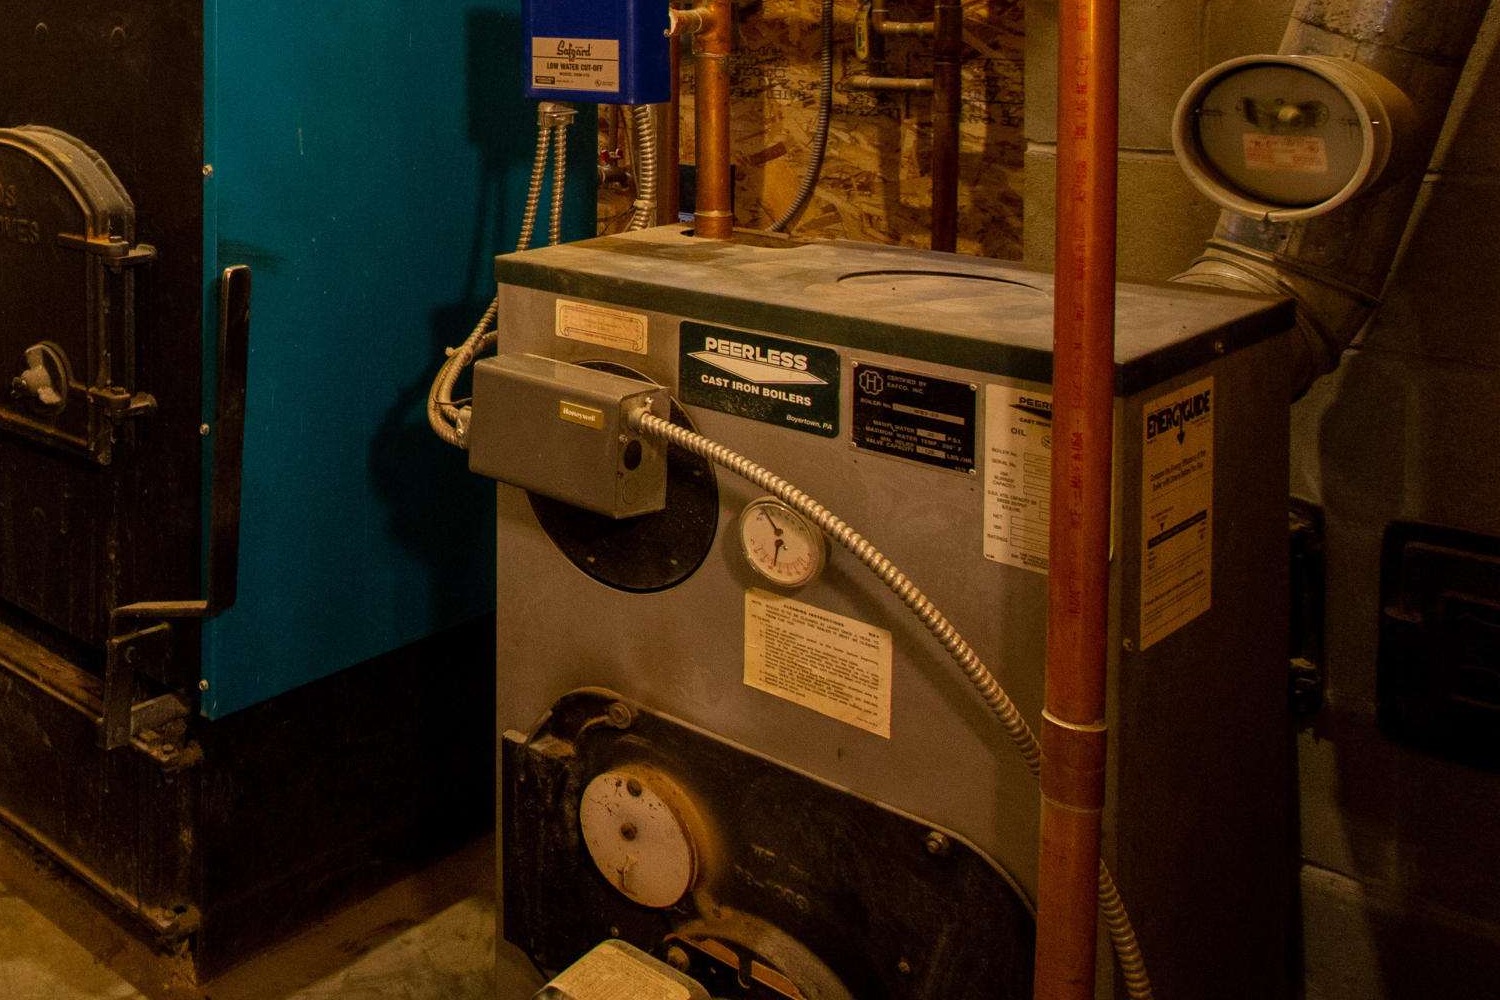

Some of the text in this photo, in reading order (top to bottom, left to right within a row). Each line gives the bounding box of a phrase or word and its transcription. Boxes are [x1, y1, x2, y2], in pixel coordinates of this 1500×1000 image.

[546, 62, 604, 72] LOW WATER CUT-OFF
[705, 336, 809, 371] PEERLESS
[701, 374, 812, 407] CAST IRON BOILERS
[1019, 396, 1052, 409] PEER
[562, 407, 596, 422] Honeywell
[786, 413, 833, 431] Boyertown, PA
[1147, 389, 1211, 440] ENERGYGUIDE
[1011, 427, 1027, 437] OIL
[783, 604, 845, 628] CLEANING INSTRUCTIONS
